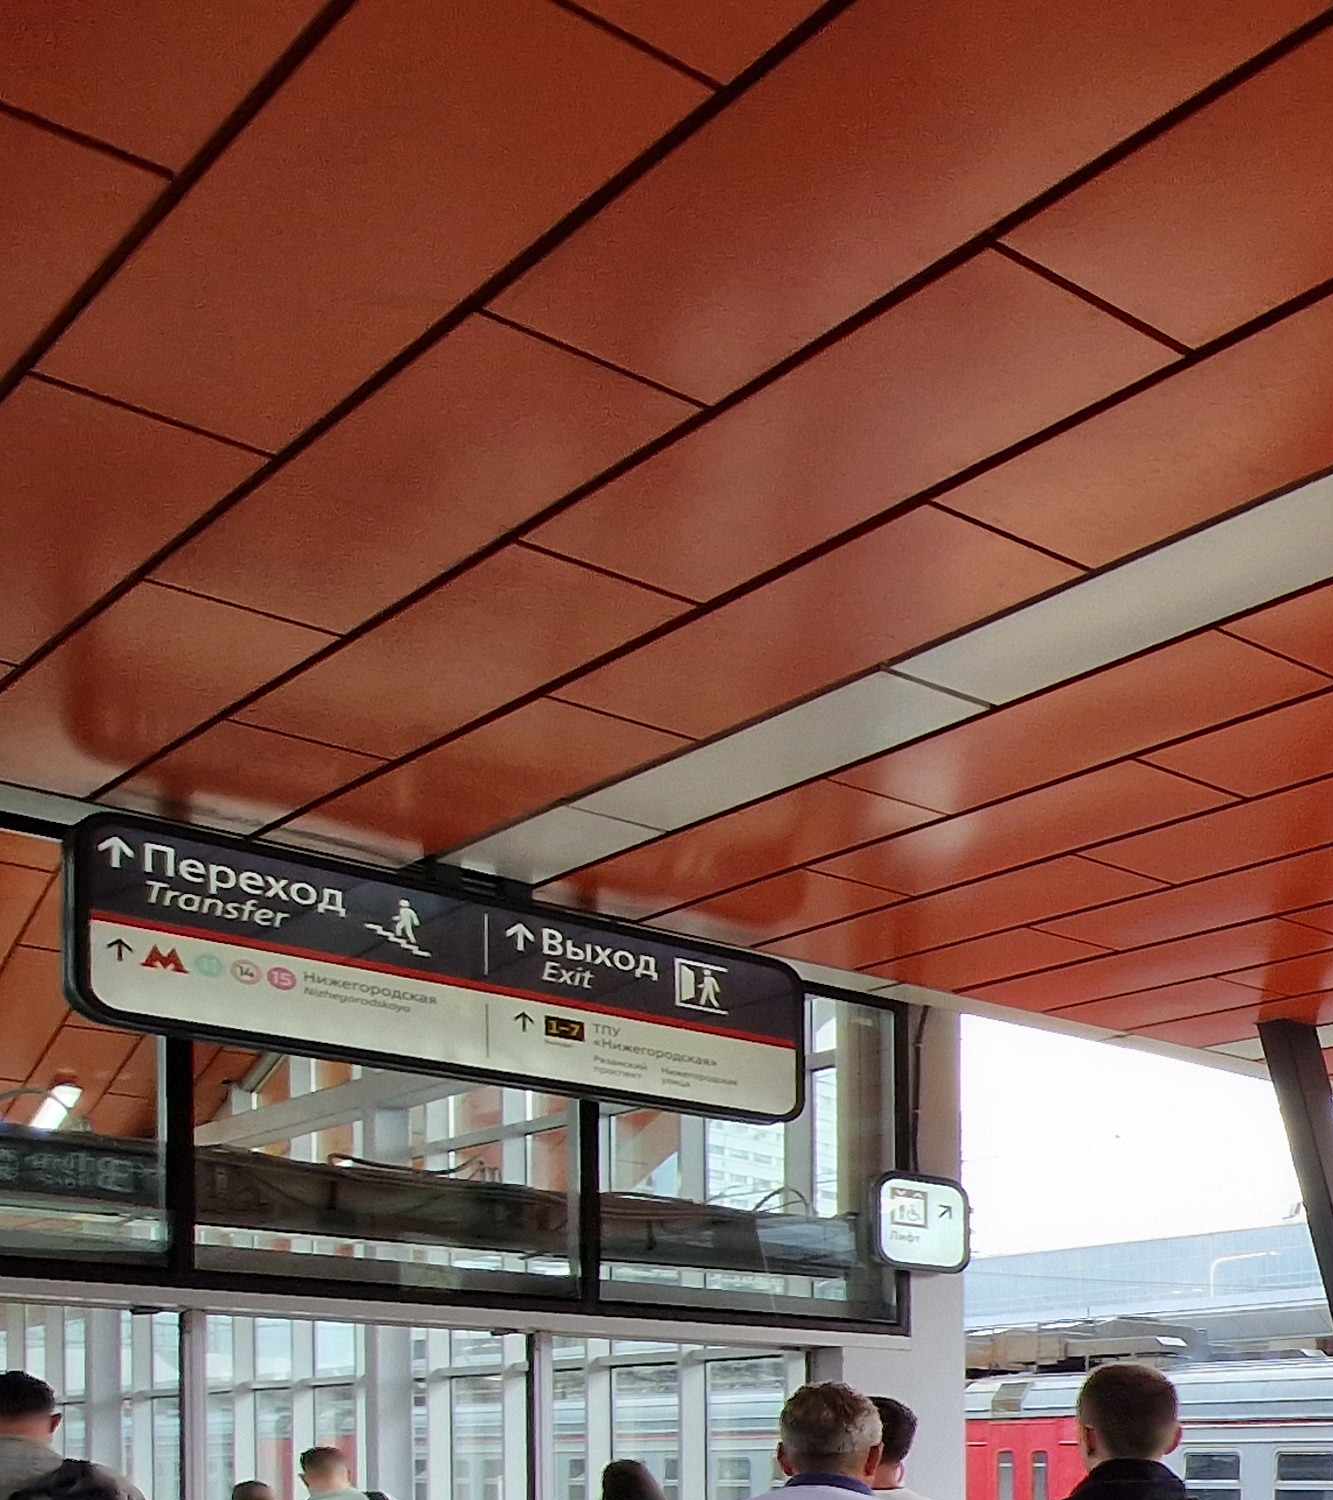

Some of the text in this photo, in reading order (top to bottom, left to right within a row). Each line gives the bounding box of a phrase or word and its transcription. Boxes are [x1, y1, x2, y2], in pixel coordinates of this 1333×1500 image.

[143, 842, 347, 918] Переход
[145, 880, 291, 928] Transfer
[271, 970, 293, 987] 15
[541, 927, 659, 982] Выход
[541, 961, 595, 989] Exit
